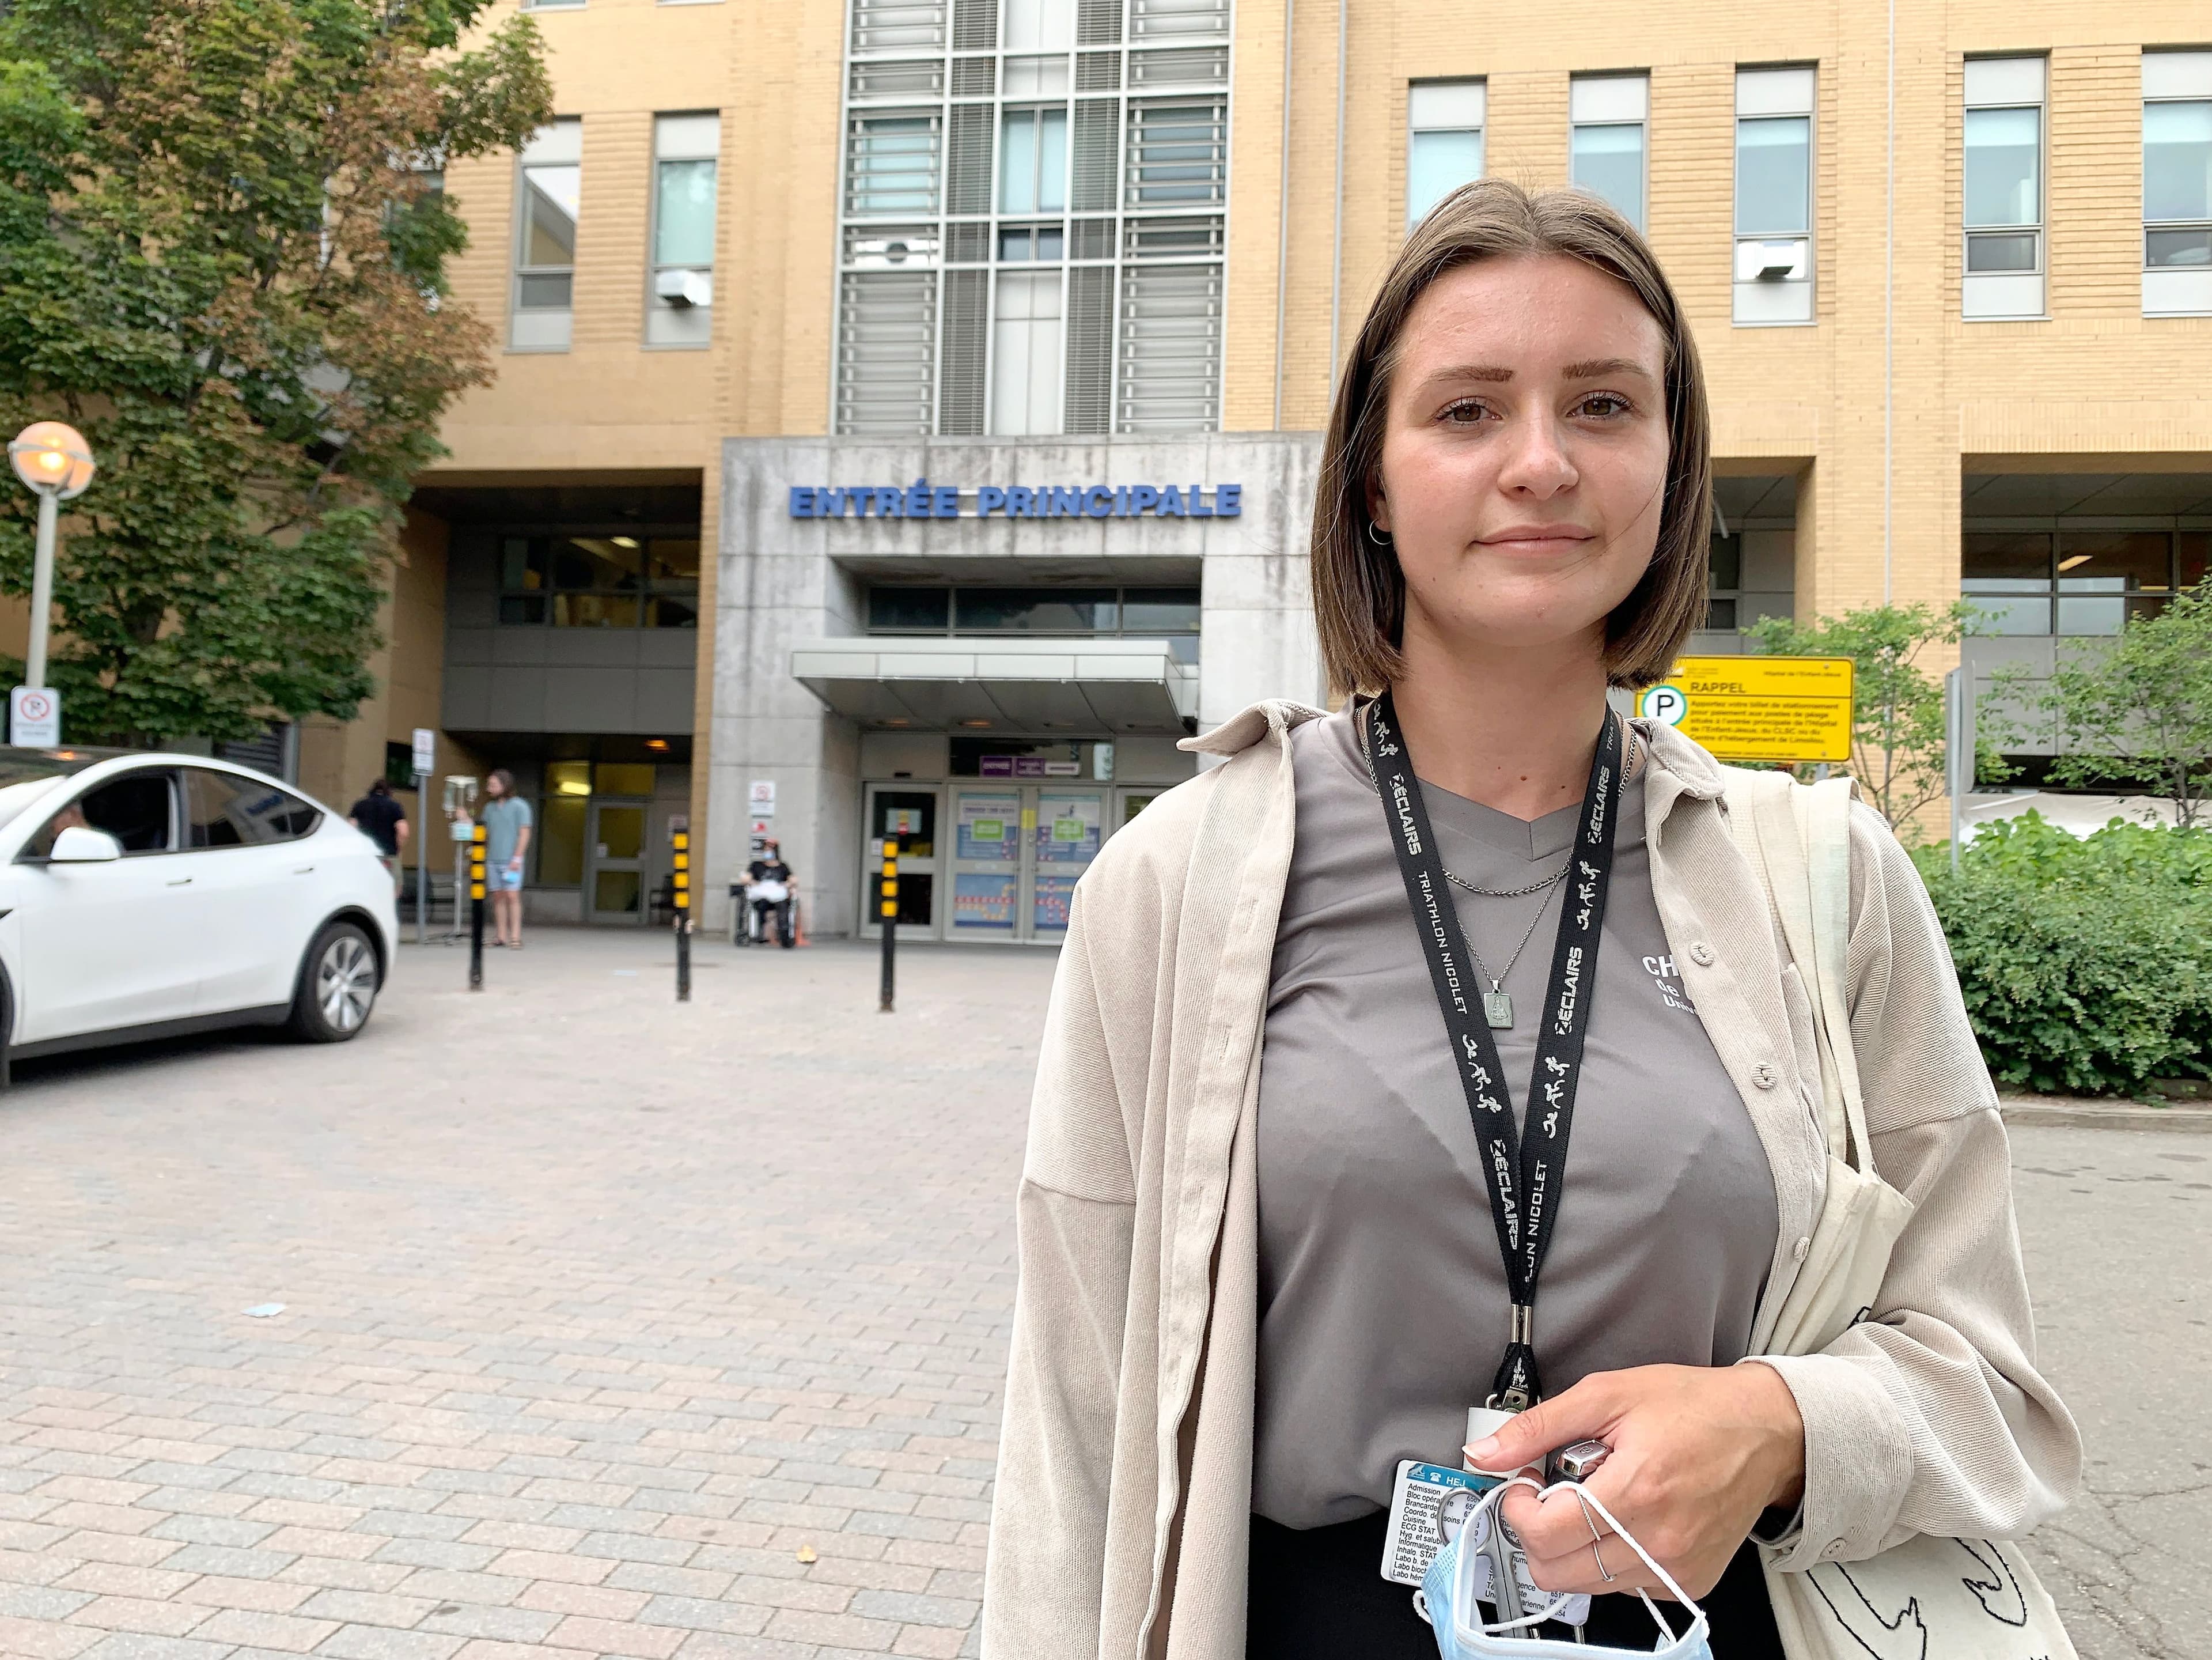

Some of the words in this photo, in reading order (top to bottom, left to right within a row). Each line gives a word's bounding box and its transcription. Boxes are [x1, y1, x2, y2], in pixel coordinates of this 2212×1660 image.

[789, 478, 959, 517] ENTRÉE
[978, 483, 1242, 517] PRINCIPALE
[1690, 682, 1747, 693] RAPPEL
[1657, 695, 1675, 716] P
[1783, 702, 1839, 710] stationnement
[1418, 871, 1448, 949] TRIATHLON
[1442, 952, 1469, 1015] NICOLET
[1654, 978, 1680, 997] de
[1662, 993, 1696, 1015] Univ
[1527, 1159, 1548, 1237] NICOLET
[1446, 1476, 1466, 1487] HEJ
[1407, 1483, 1441, 1496] Admission
[1407, 1490, 1421, 1500] Bloc
[1406, 1498, 1439, 1511] Brancarde
[1402, 1514, 1426, 1525] Cuisine
[1404, 1506, 1429, 1518] Coordo.
[1443, 1515, 1461, 1525] soins
[1401, 1522, 1417, 1531] ECG
[1418, 1525, 1436, 1535] STAT
[1399, 1529, 1414, 1540] Hyg.
[1423, 1536, 1442, 1545] salubr
[1398, 1537, 1438, 1552] Informatique
[1396, 1545, 1418, 1556] Inhalo.
[1419, 1550, 1437, 1559] STAT
[1394, 1561, 1410, 1571] Labo
[1395, 1553, 1412, 1563] Labo
[1420, 1559, 1429, 1567] de
[1392, 1568, 1409, 1579] Labo
[1521, 1600, 1546, 1610] arienne
